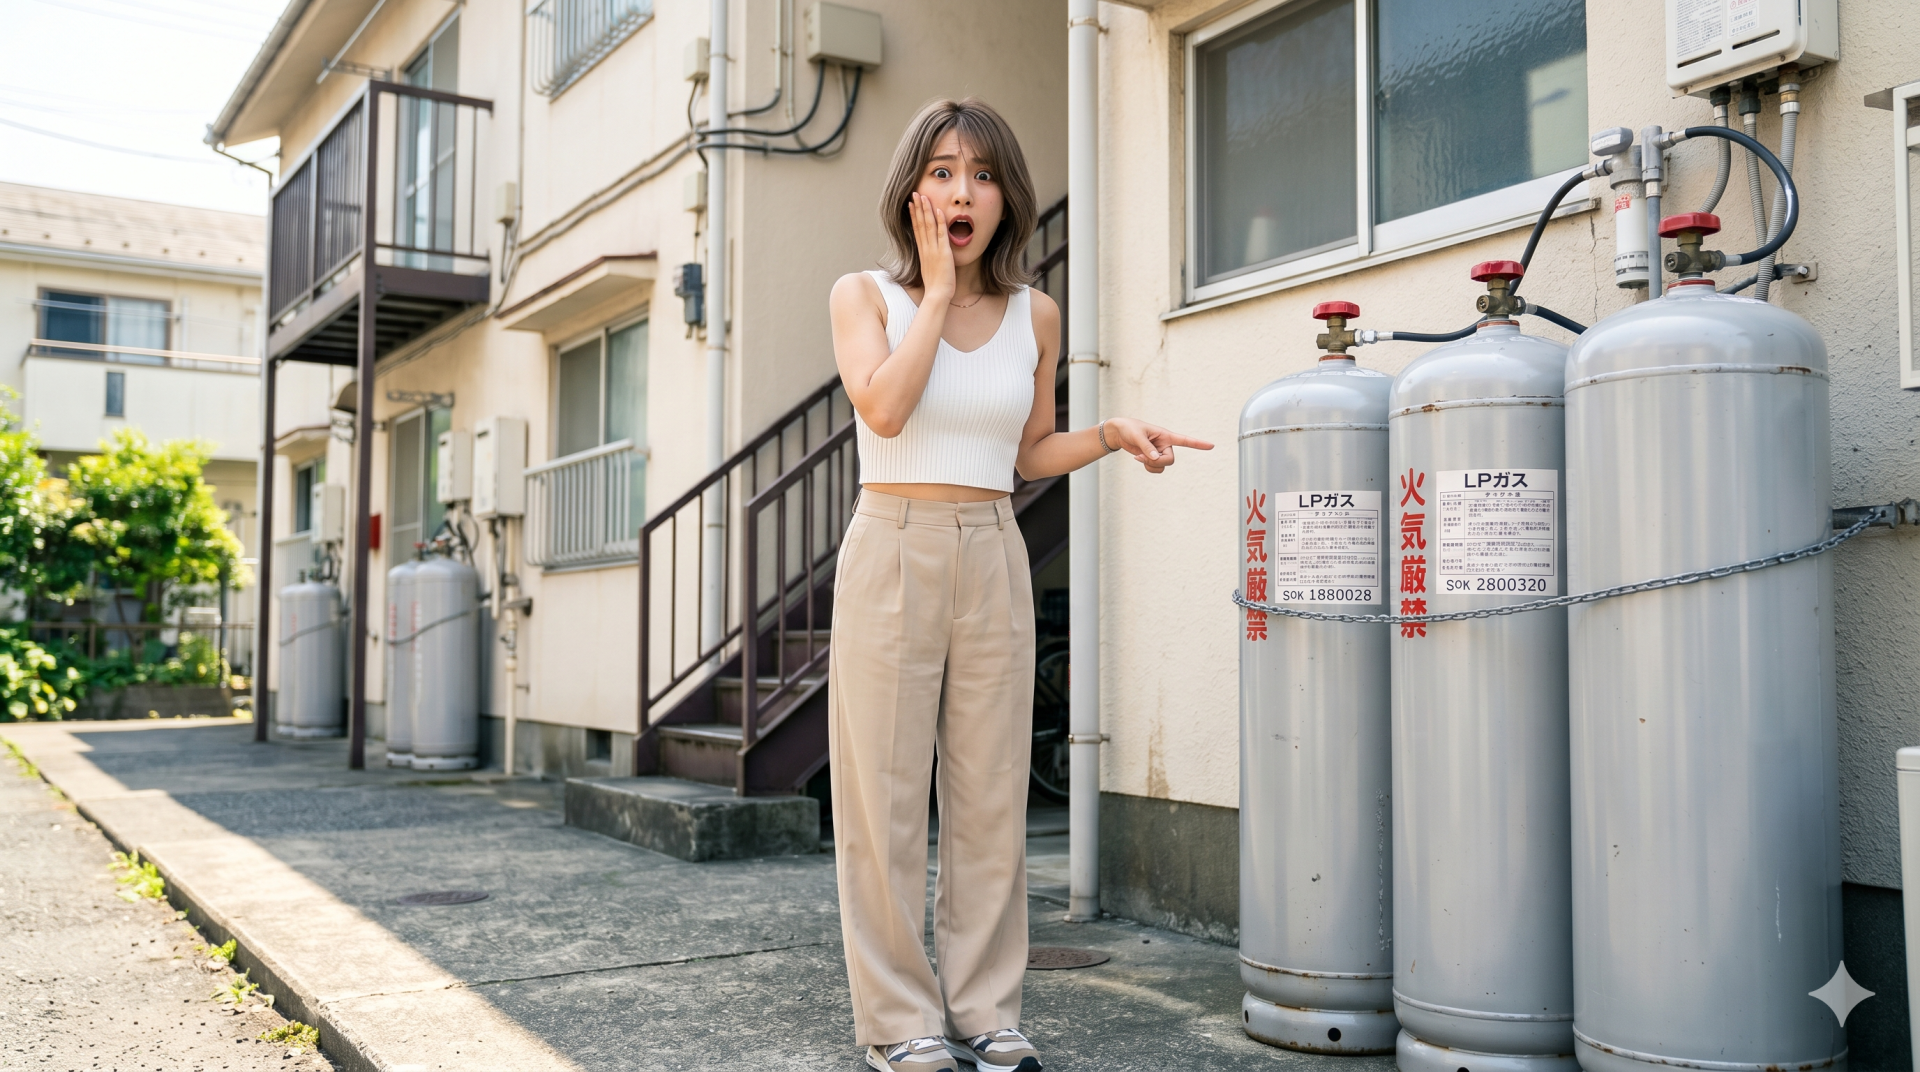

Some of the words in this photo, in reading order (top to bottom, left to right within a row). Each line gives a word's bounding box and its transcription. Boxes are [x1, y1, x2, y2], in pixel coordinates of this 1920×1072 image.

[1464, 471, 1529, 488] LPガス
[1299, 493, 1355, 508] LPガス
[1400, 467, 1427, 638] 火気厳禁
[1246, 489, 1268, 642] 火気厳禁
[1476, 577, 1547, 592] 2800320
[1309, 588, 1372, 601] 1880028
